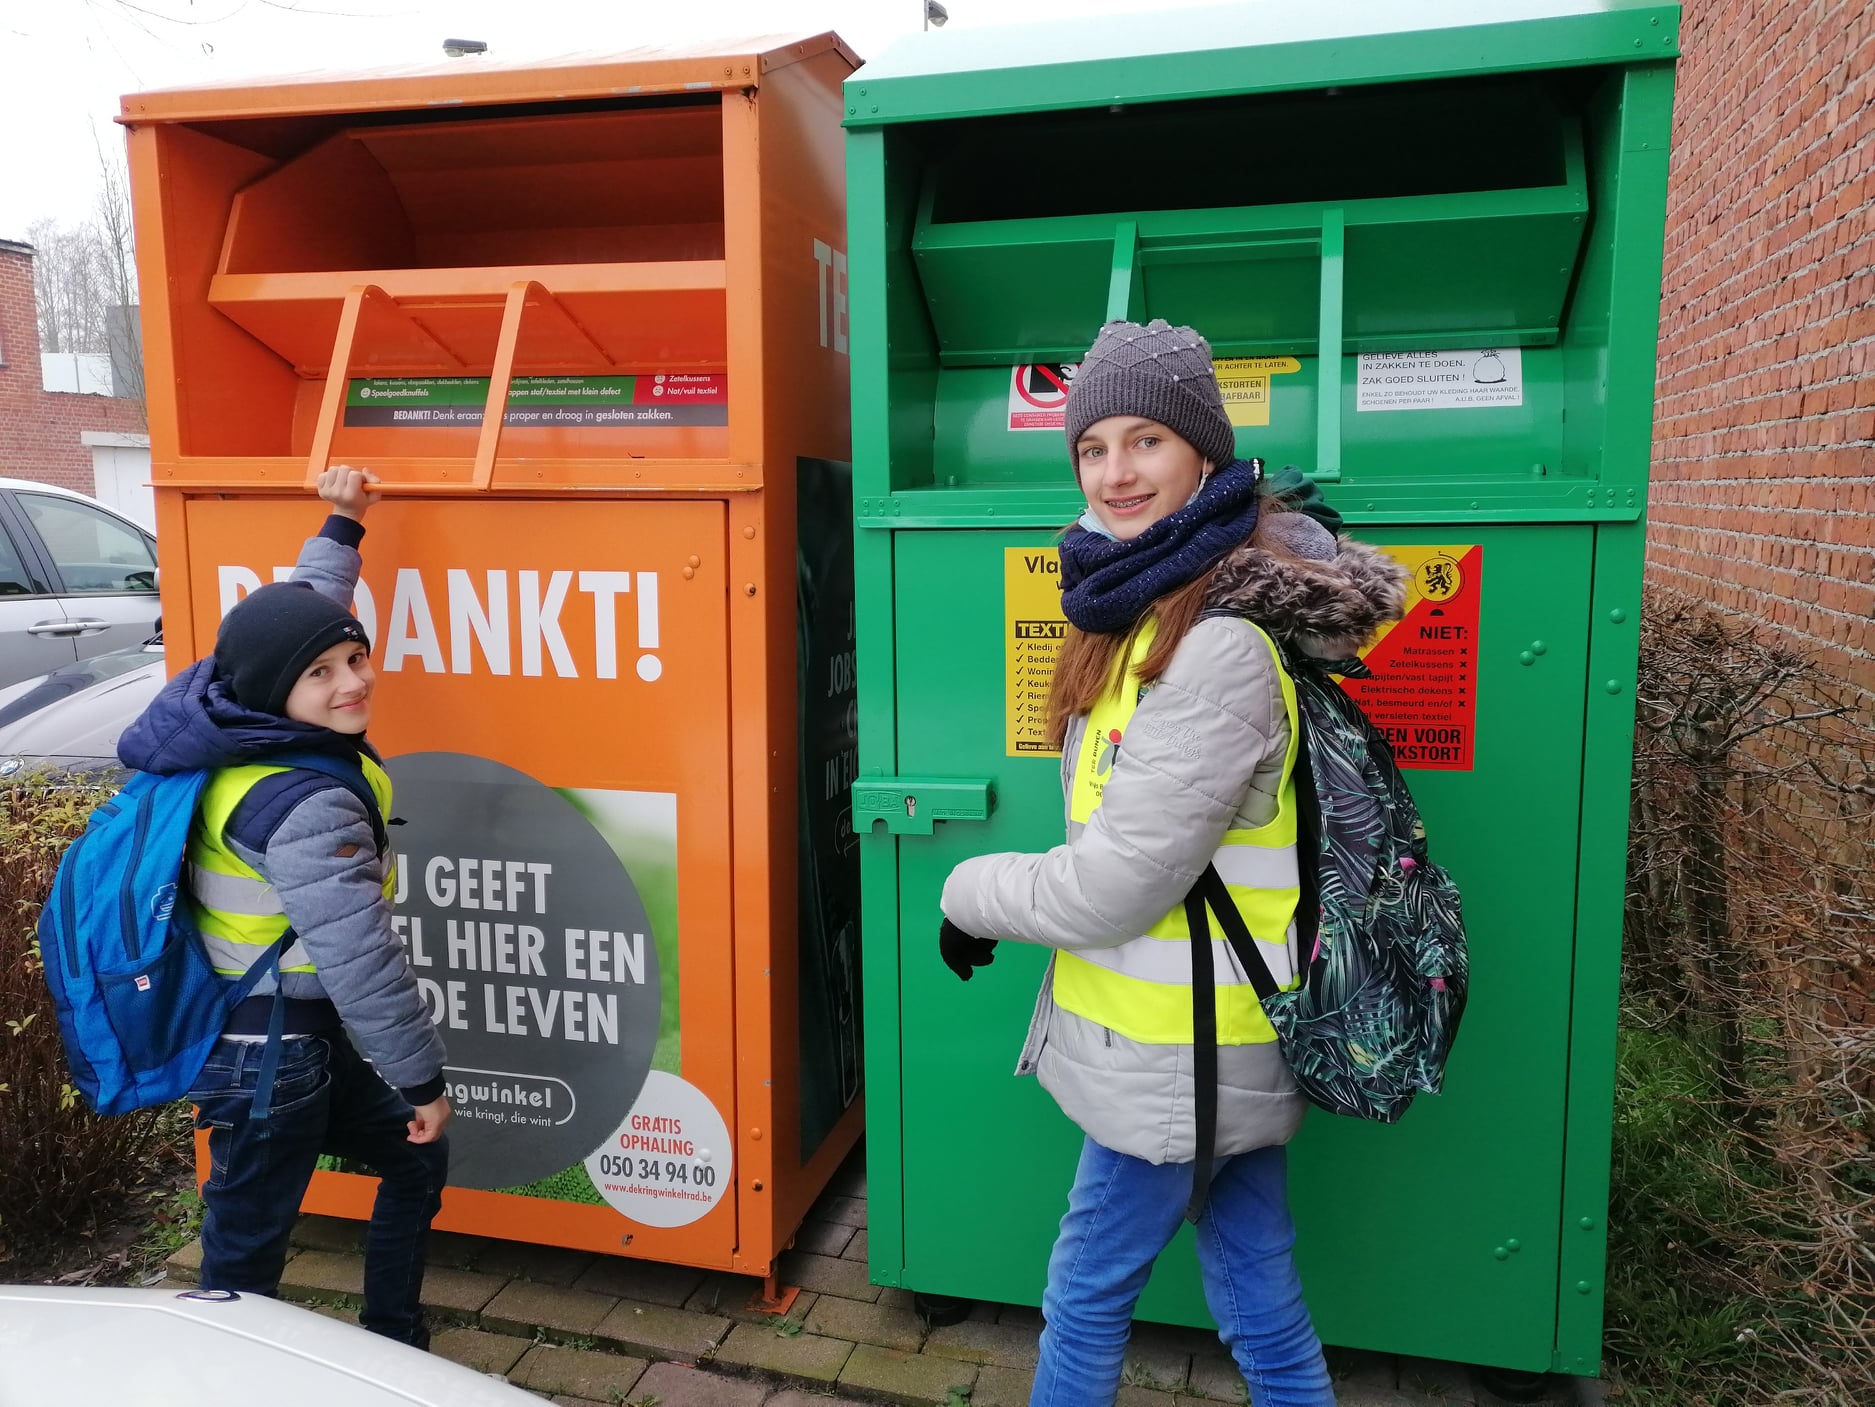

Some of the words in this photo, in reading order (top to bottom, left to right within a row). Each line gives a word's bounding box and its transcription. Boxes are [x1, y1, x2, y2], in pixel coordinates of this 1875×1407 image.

[1362, 352, 1404, 361] GELIEVE
[1406, 351, 1438, 359] ALLES
[1224, 362, 1253, 370] ACHTER
[1375, 362, 1416, 370] ZAKKEN
[1362, 377, 1382, 385] ZAK
[1385, 375, 1414, 384] GOED
[1417, 374, 1460, 383] SLUITEN
[371, 388, 429, 398] Speelgoedknuffels
[530, 388, 567, 397] stof/textiel
[582, 387, 598, 395] klein
[600, 387, 621, 395] defect
[667, 387, 696, 395] Nat/vuil
[393, 410, 431, 420] BEDANKT!
[432, 409, 455, 420] Denk
[509, 412, 540, 422] proper
[542, 412, 553, 420] en
[555, 409, 583, 422] droog
[585, 410, 594, 419] in
[596, 409, 634, 422] gesloten
[636, 408, 674, 420] zakken.
[1420, 626, 1469, 640] NIET:
[1027, 642, 1053, 653] Kledij
[1403, 647, 1454, 656] Matrassen
[1389, 660, 1454, 669] Zetelkussens
[1027, 680, 1051, 688] Keuk
[1427, 674, 1454, 683] tapijt
[1360, 685, 1415, 694] Elektrische
[1418, 686, 1453, 695] dekens
[1376, 699, 1425, 708] besmeurd
[1427, 700, 1453, 708] en/of
[1375, 712, 1419, 720] versleten
[1422, 713, 1452, 721] textiel
[1413, 727, 1461, 744] VOOR
[425, 856, 552, 914] GEEFT
[446, 919, 547, 977] HIER
[565, 928, 645, 985] EEN
[484, 983, 619, 1045] LEVEN
[455, 1107, 472, 1118] wie
[475, 1107, 507, 1124] kringt,
[511, 1112, 526, 1124] die
[529, 1116, 551, 1127] wint
[631, 1114, 682, 1135] GRATIS
[620, 1134, 694, 1156] OPHALING
[600, 1154, 633, 1178] 050
[638, 1158, 660, 1181] 34
[665, 1161, 688, 1184] 94
[693, 1165, 716, 1187] 00
[604, 1183, 712, 1203] www.dekringwinkeltrad.be
